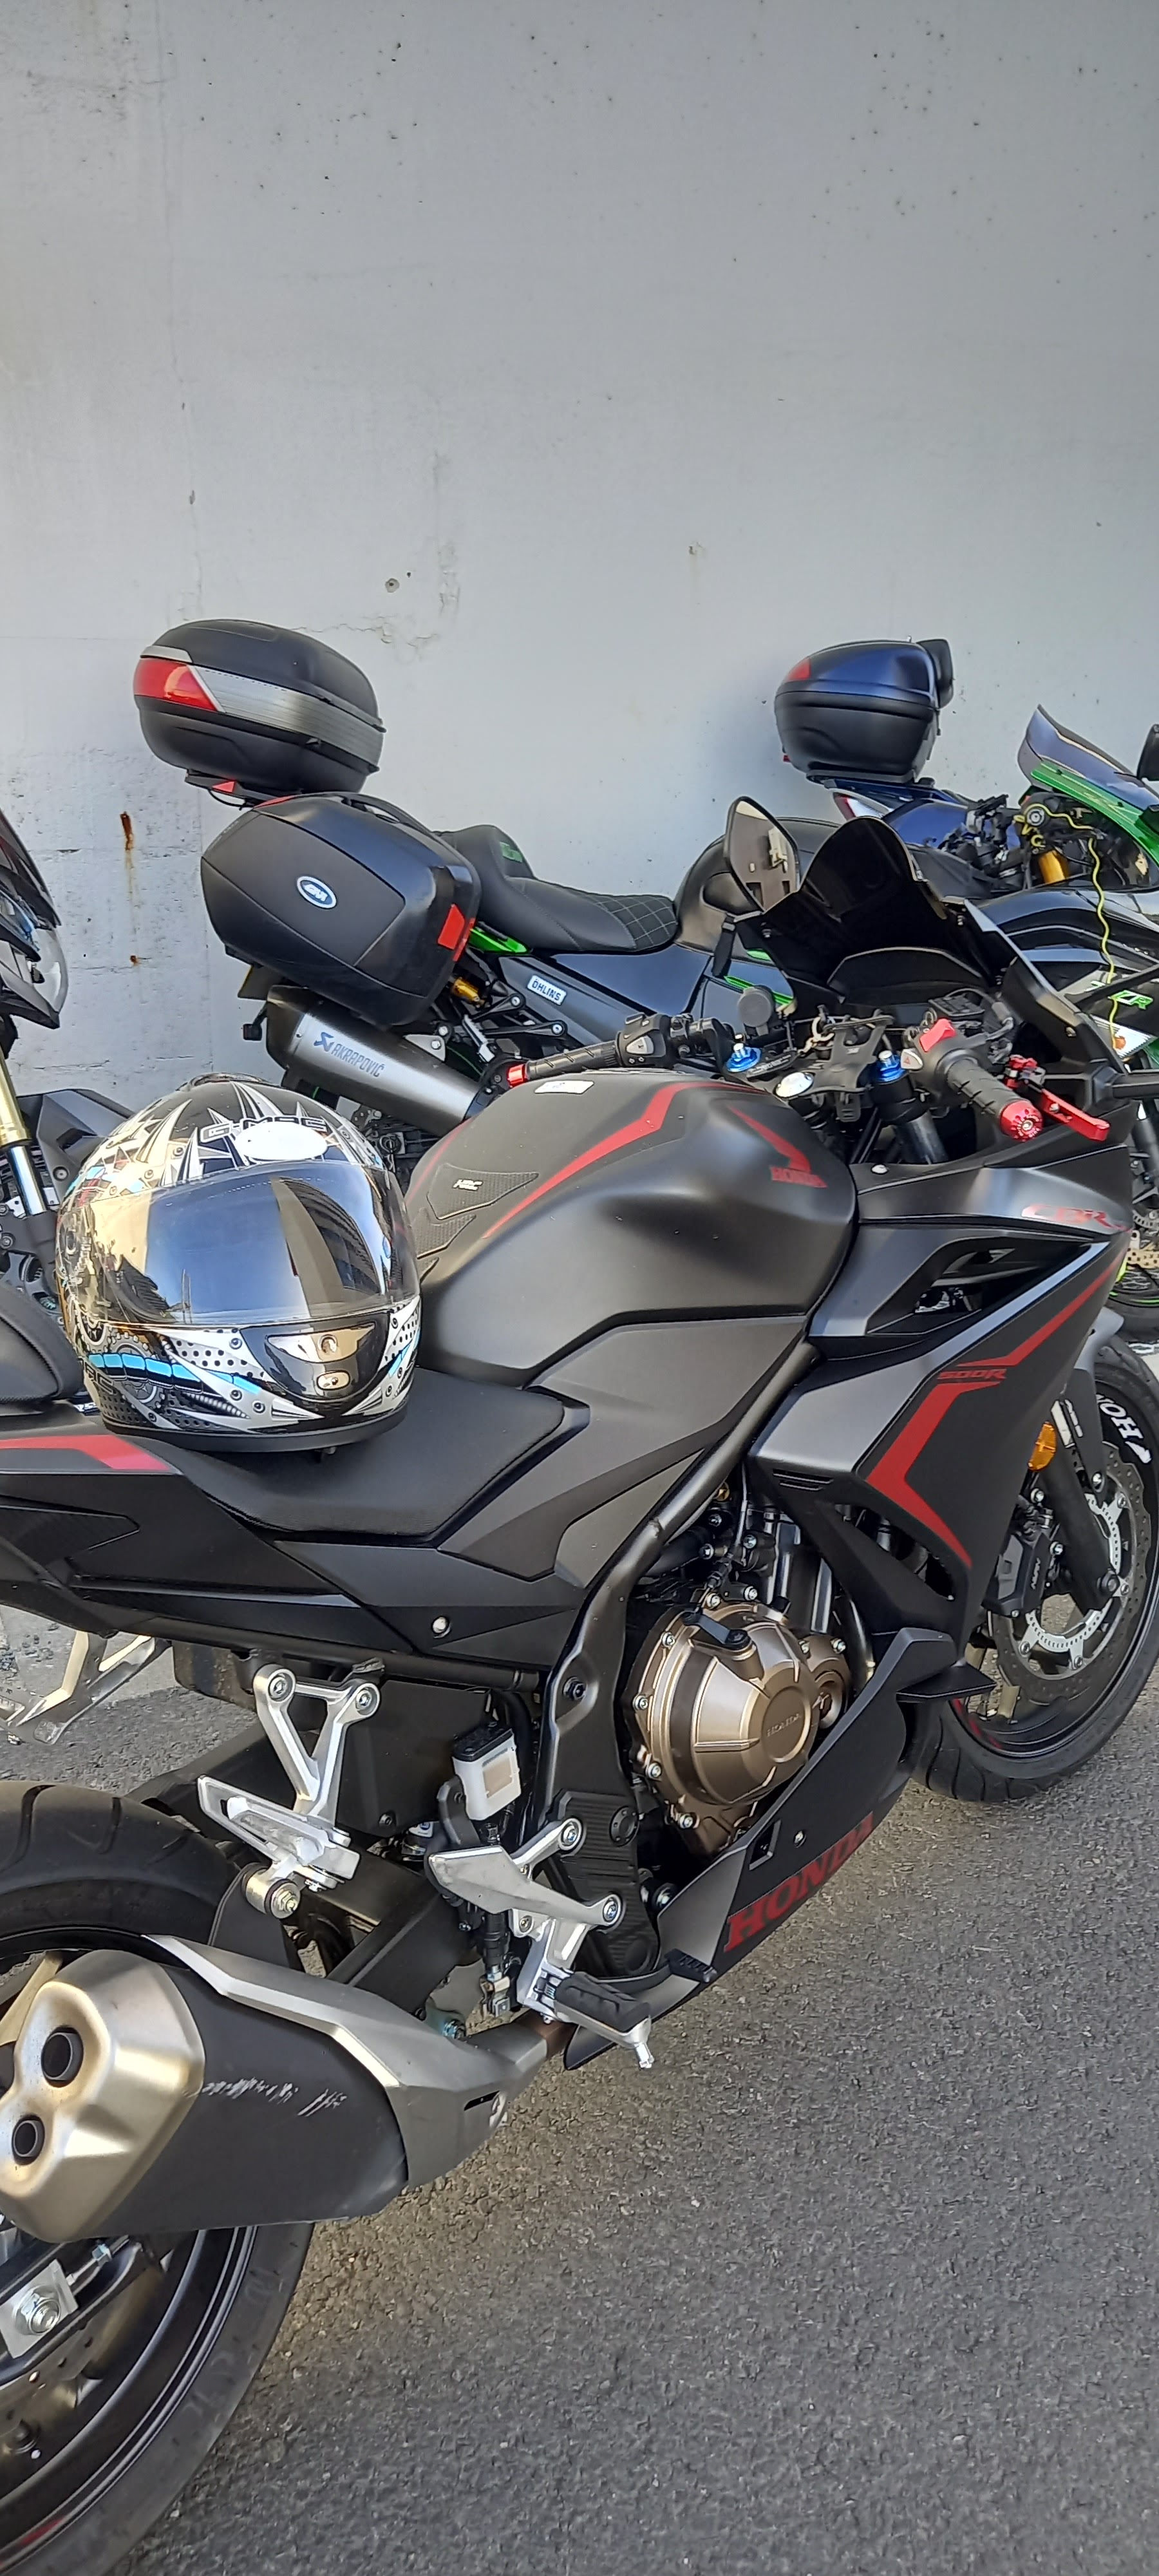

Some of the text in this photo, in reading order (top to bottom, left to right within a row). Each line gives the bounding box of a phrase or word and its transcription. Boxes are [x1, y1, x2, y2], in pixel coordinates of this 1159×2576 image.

[532, 978, 561, 1001] ÖHLINS
[938, 1368, 1007, 1380] 500R
[767, 1712, 801, 1737] HONDA
[723, 1810, 874, 1953] HONDA
